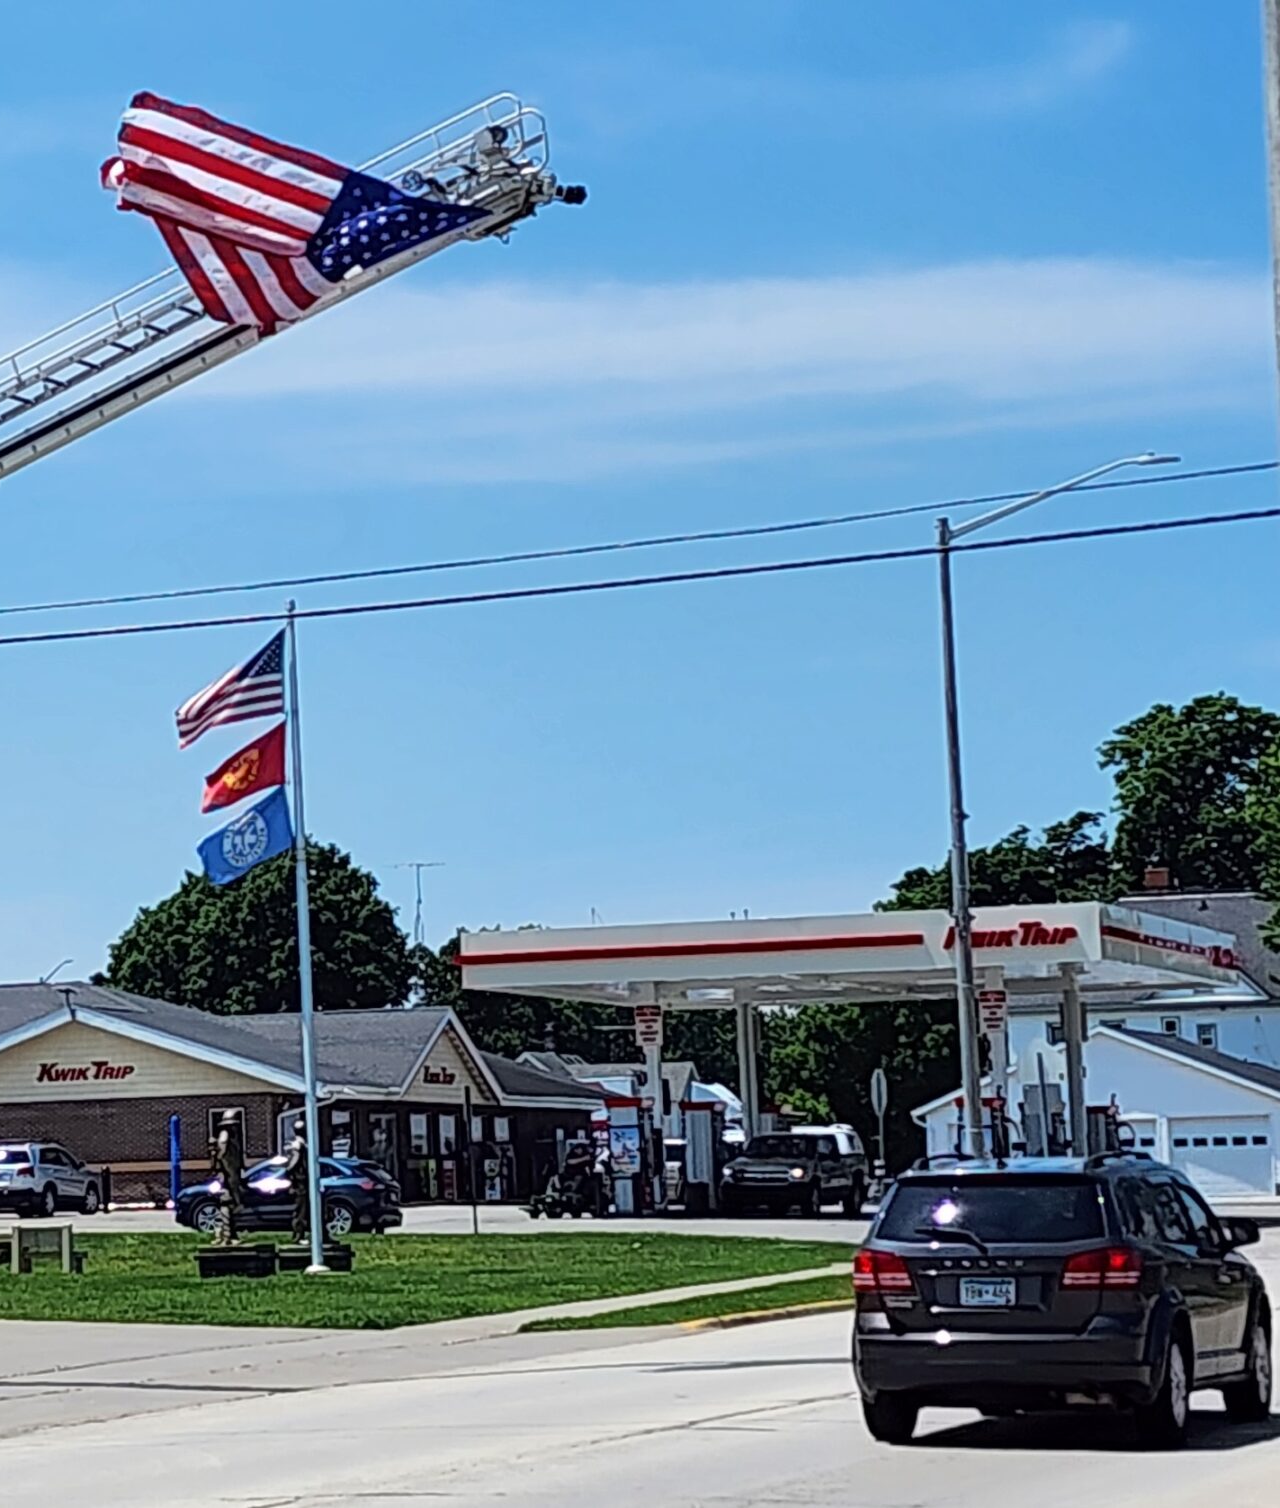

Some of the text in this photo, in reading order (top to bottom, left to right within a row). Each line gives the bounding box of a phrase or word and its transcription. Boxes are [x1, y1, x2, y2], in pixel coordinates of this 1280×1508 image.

[1018, 921, 1078, 946] TRIP
[36, 1060, 135, 1083] KWIK TRIP
